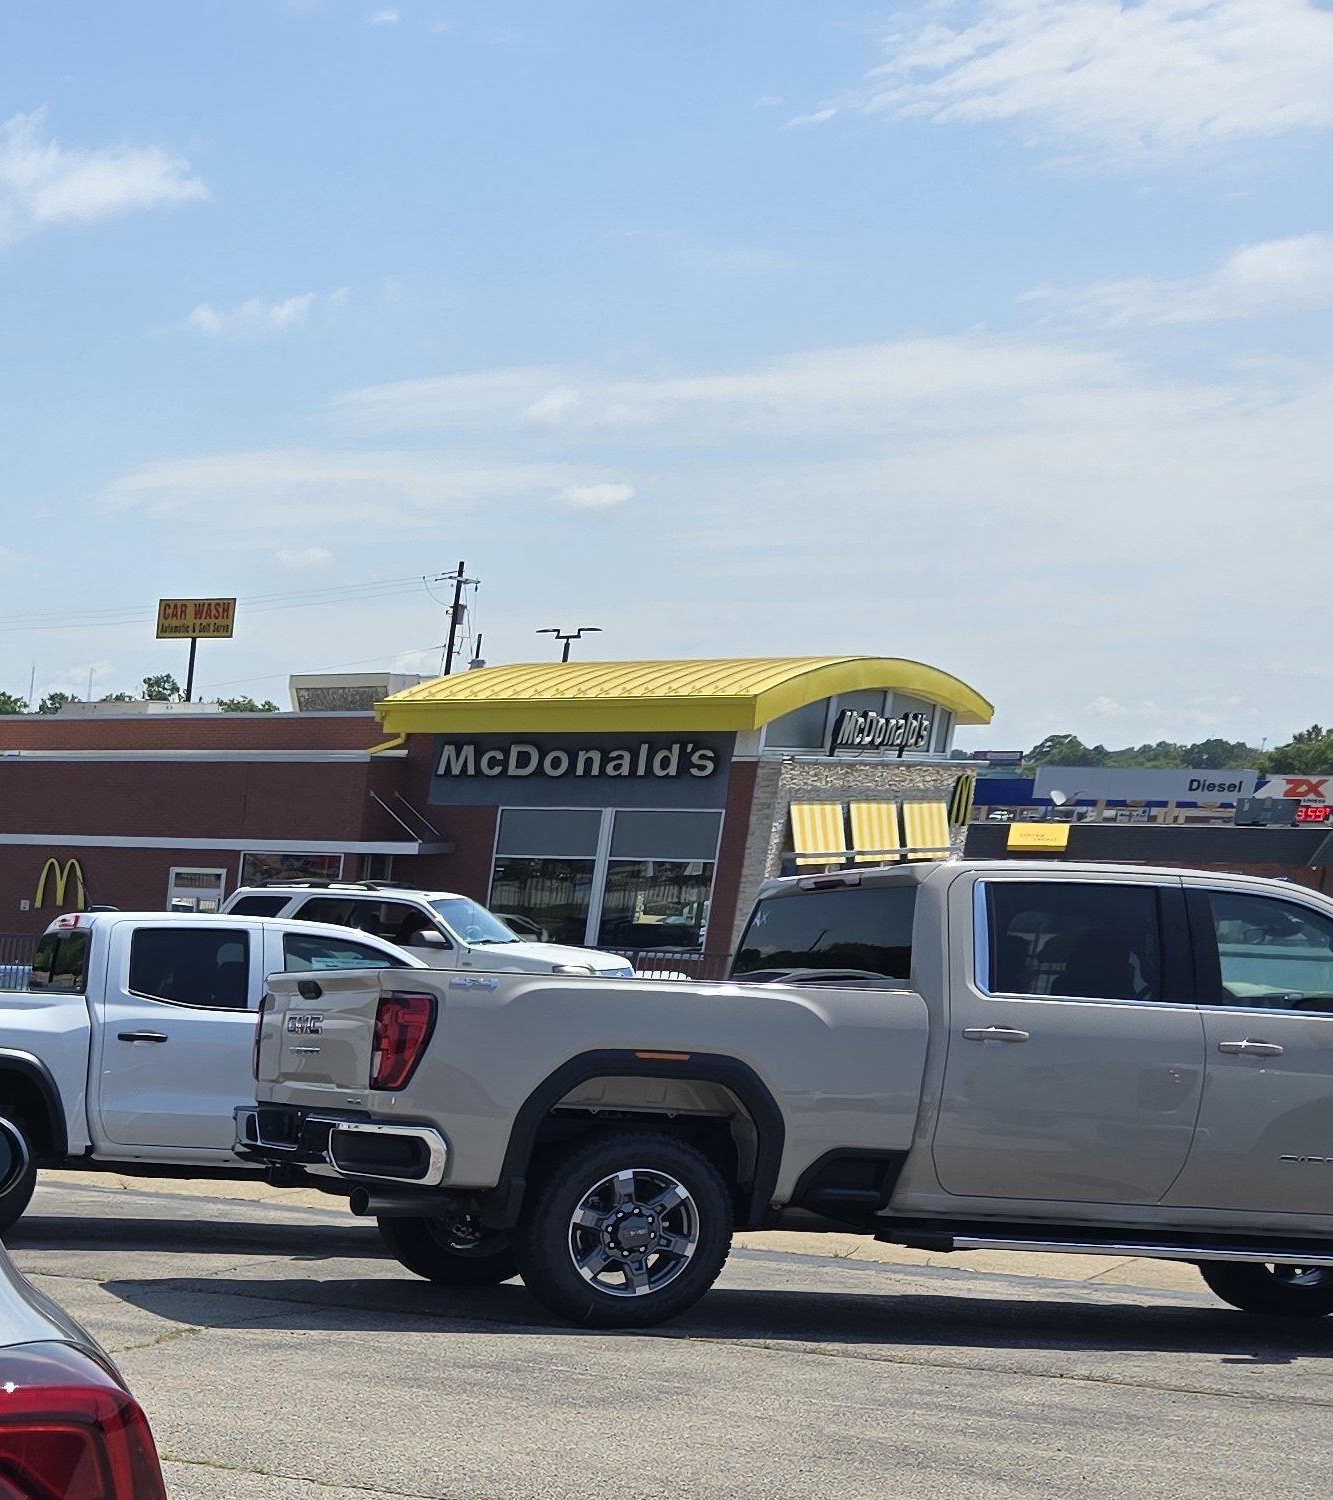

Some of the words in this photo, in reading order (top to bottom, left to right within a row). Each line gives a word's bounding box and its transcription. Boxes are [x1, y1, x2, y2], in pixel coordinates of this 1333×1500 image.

[162, 603, 187, 621] CAR
[193, 602, 230, 620] WASH
[834, 710, 930, 748] McDonald's
[436, 742, 717, 778] McDonald's
[1188, 778, 1243, 794] Diesel
[1283, 779, 1330, 798] ZX
[288, 1014, 324, 1035] GMC
